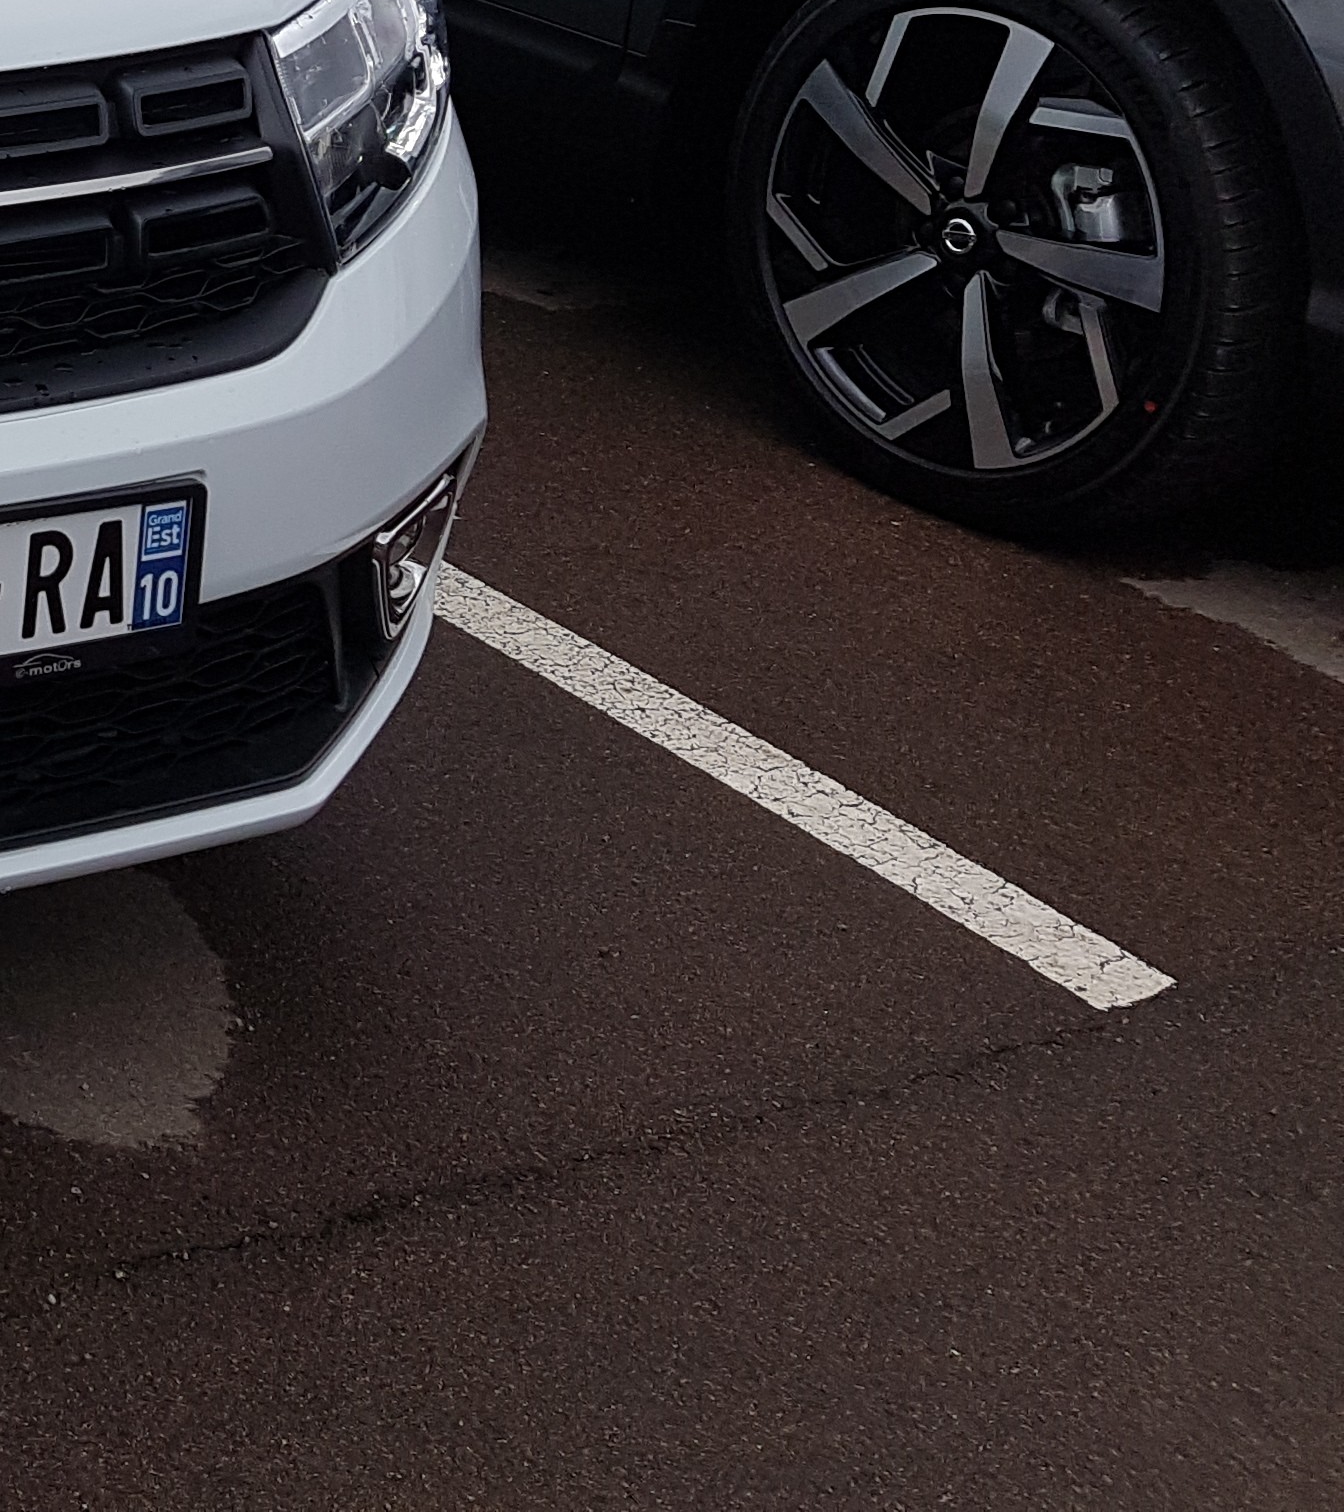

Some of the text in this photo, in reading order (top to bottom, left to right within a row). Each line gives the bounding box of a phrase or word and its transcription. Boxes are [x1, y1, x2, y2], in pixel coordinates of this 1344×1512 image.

[148, 510, 183, 526] Grand
[146, 524, 181, 549] Est
[140, 570, 179, 620] 10
